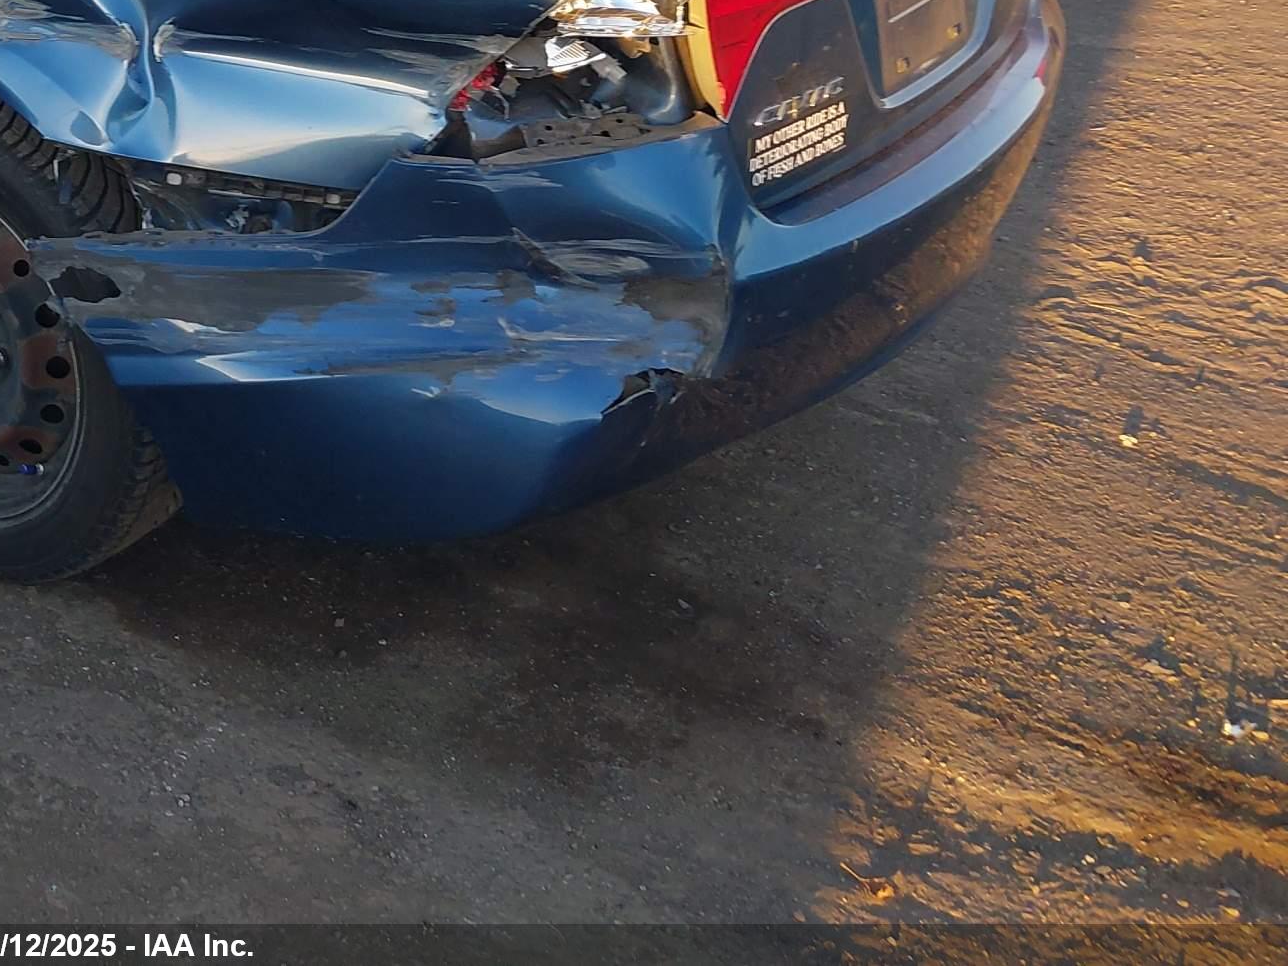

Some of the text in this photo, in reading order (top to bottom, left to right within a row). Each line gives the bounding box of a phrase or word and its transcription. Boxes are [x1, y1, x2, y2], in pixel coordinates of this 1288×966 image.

[752, 76, 846, 126] CIVIC
[755, 134, 773, 153] MY
[773, 120, 806, 144] OTHER
[824, 114, 850, 137] BODY
[752, 169, 768, 186] OF
[794, 147, 815, 167] AND
[815, 132, 845, 156] BONES
